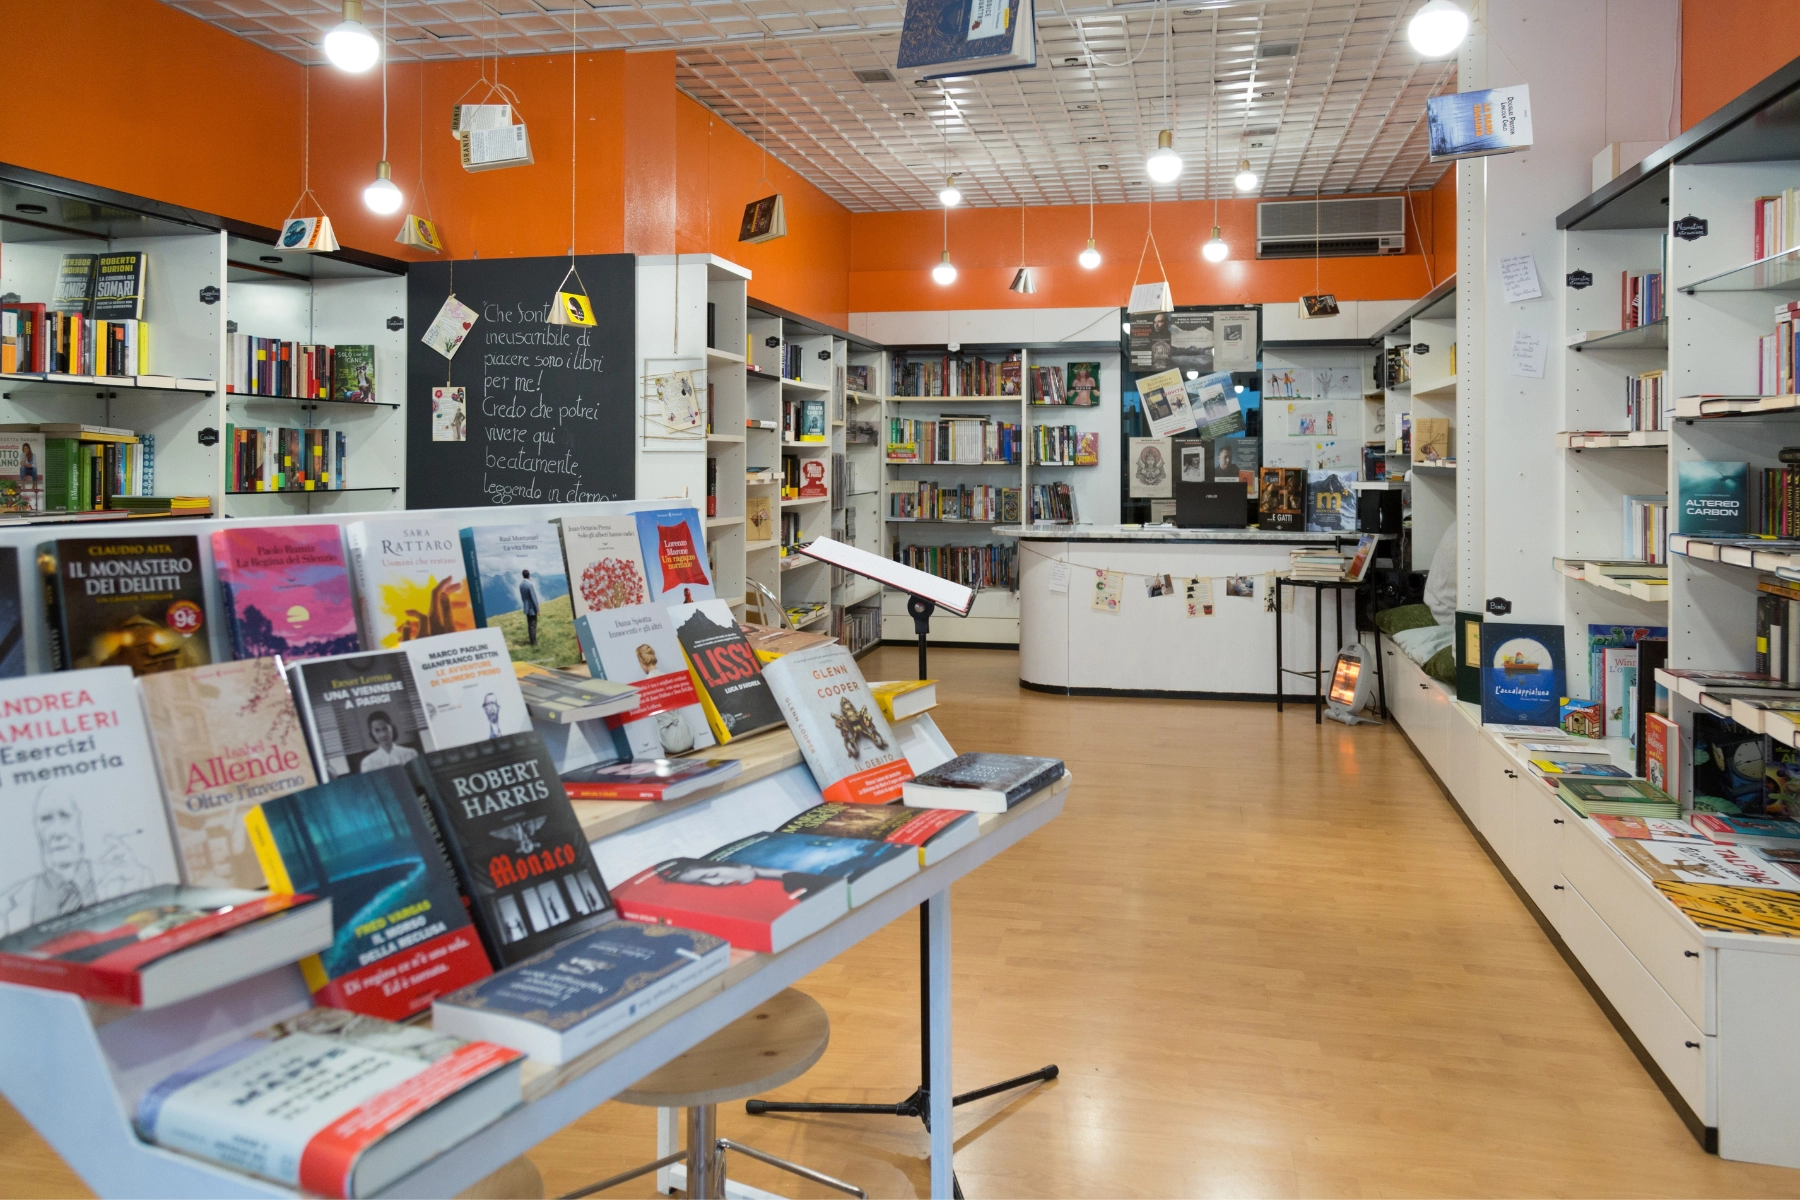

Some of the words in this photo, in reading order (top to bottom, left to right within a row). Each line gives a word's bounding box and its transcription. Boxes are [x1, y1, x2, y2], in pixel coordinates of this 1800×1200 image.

[452, 106, 460, 130] URANIA
[462, 133, 470, 163] URANIA
[309, 219, 321, 246] URANIA
[100, 256, 136, 266] ROBERTO
[101, 264, 134, 274] BURIONI
[98, 280, 135, 297] SOMARI
[576, 327, 591, 347] di
[484, 352, 530, 376] piacere
[534, 355, 563, 368] sono
[566, 352, 573, 369] i
[573, 346, 604, 373] libri
[484, 375, 509, 397] per
[515, 369, 543, 392] me!
[482, 395, 526, 418] Credo
[530, 392, 553, 418] che
[559, 394, 600, 426] potrei
[484, 424, 527, 442] vivere
[533, 427, 556, 456] qui
[485, 445, 582, 478] beatamente,
[483, 472, 541, 504] leggendo
[548, 486, 561, 503] in
[1685, 499, 1740, 508] ALTERED
[1686, 508, 1739, 516] CARBON
[1277, 514, 1293, 522] GATTI
[403, 528, 431, 538] SARA
[568, 525, 580, 533] Juan
[580, 524, 598, 532] Octavio
[381, 539, 453, 553] RATTARO
[499, 534, 511, 542] Raul
[510, 543, 522, 551] vita
[663, 540, 688, 548] Lorenzo
[88, 545, 145, 556] CLAUDIO
[146, 544, 173, 554] AITA
[257, 546, 284, 556] Paolo
[661, 555, 672, 563] Un
[672, 553, 696, 563] ragazzo
[666, 547, 689, 555] Marone
[68, 561, 87, 579] IL
[89, 557, 193, 577] MONASTERO
[235, 557, 250, 569] La
[250, 555, 287, 568] Regina
[287, 554, 300, 566] del
[301, 553, 338, 566] Silenzio
[381, 557, 416, 568] Uomini
[417, 557, 433, 566] che
[434, 556, 457, 566] restano
[667, 561, 693, 570] normale
[85, 577, 116, 595] DEI
[119, 575, 182, 594] DELITTI
[1490, 601, 1506, 610] Bimbi
[614, 619, 632, 628] Dana
[631, 615, 653, 626] Spiotta
[608, 627, 638, 639] Innocenti
[643, 624, 653, 634] gli
[652, 623, 663, 631] altri
[421, 655, 473, 671] GIANFRANCO
[475, 650, 499, 661] BETTIN
[429, 648, 458, 660] MARCO
[459, 643, 489, 655] PAOLINI
[435, 668, 446, 677] LE
[448, 659, 492, 674] AVVENTURE
[692, 641, 761, 688] LISSY
[812, 664, 848, 680] GLENN
[429, 679, 440, 688] DI
[441, 671, 476, 684] NUMERO
[477, 667, 502, 678] PRIMO
[724, 685, 740, 694] LUCA
[737, 679, 761, 690] D'ANDREA
[324, 688, 350, 702] UNA
[351, 680, 404, 697] VIENNESE
[817, 681, 860, 699] COOPER
[1495, 686, 1549, 697] L'accalappialuna
[0, 689, 95, 719] NDREA
[344, 698, 354, 710] A
[356, 693, 392, 708] PARIGI
[785, 697, 799, 723] GLENN
[799, 724, 816, 755] COOPER
[0, 735, 97, 767] Esercizi
[224, 741, 266, 761] Isabel
[13, 753, 124, 784] memoria
[184, 744, 301, 796] Allende
[855, 763, 864, 772] IL
[865, 753, 894, 768] DEBITO
[452, 759, 541, 798] ROBERT
[186, 790, 234, 813] Oltre
[236, 773, 306, 805] l'inverno
[461, 779, 550, 820] HARRIS
[488, 842, 577, 889] Monaco
[355, 916, 387, 938] FRED
[386, 900, 432, 924] VARGAS
[358, 940, 398, 966] DELLA
[397, 920, 448, 949] RECLUSA
[371, 931, 386, 946] IL
